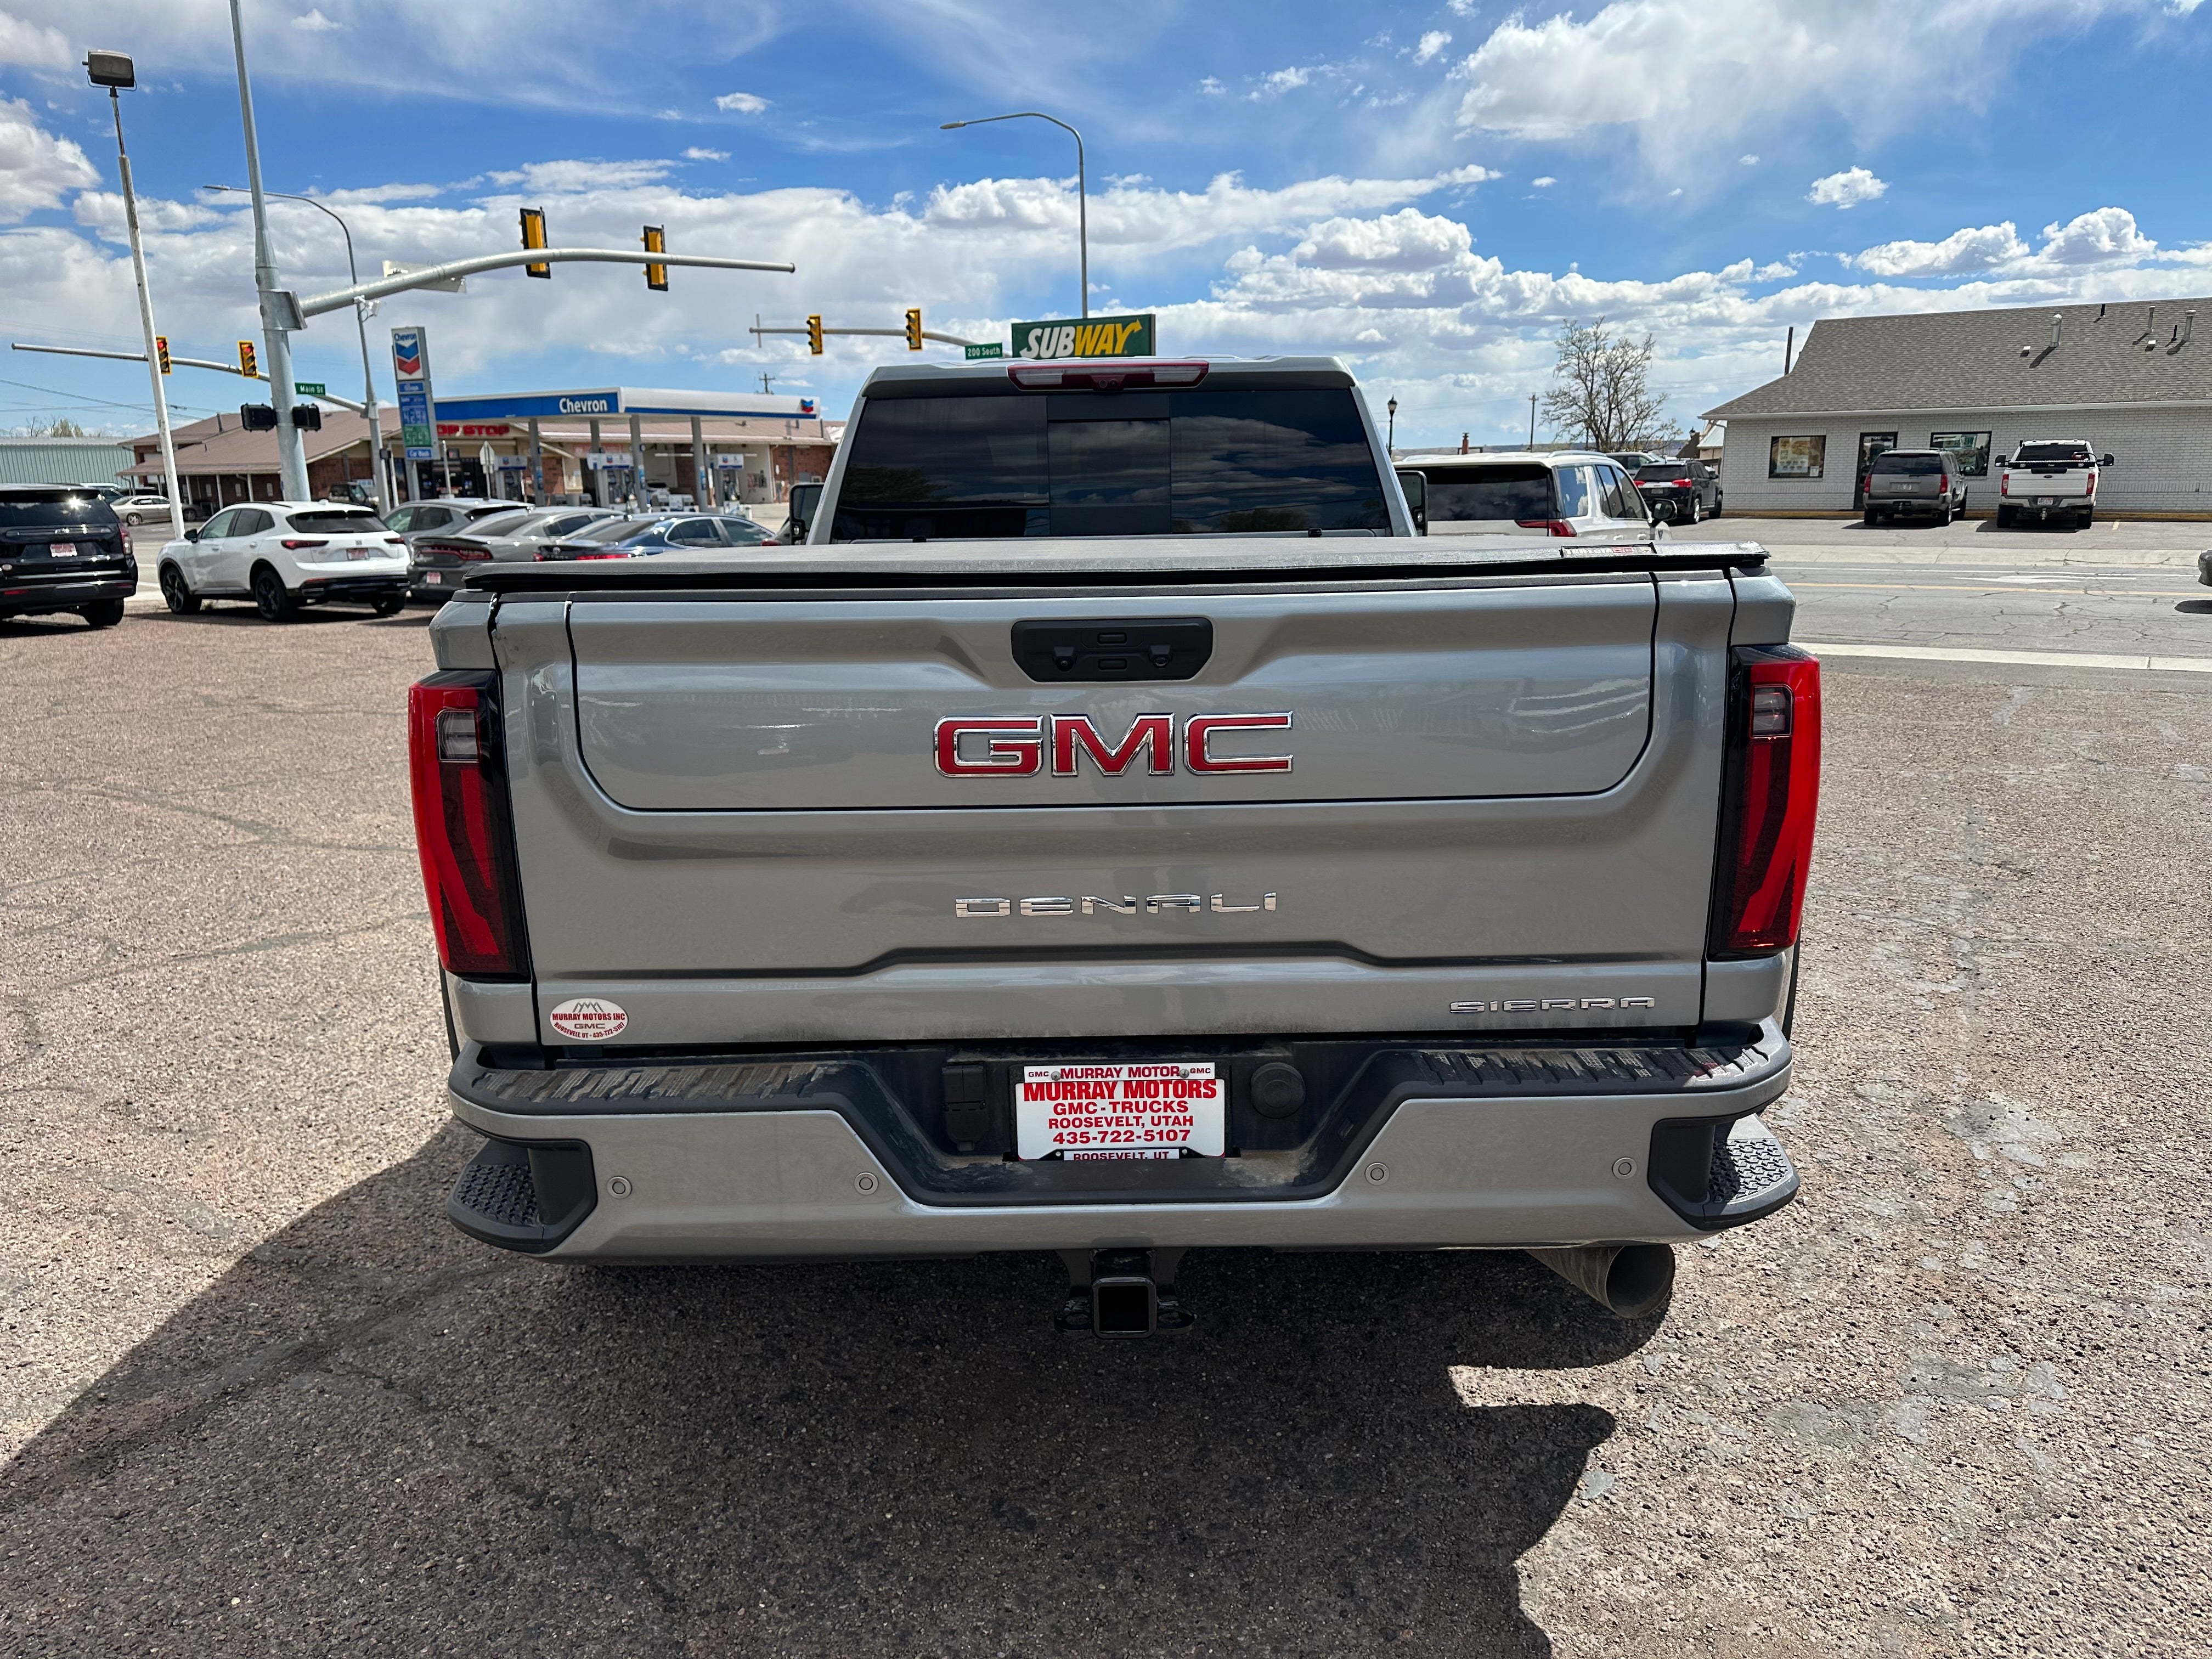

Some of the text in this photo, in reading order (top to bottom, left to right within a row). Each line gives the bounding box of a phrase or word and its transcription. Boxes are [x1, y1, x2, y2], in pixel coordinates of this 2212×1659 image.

[394, 332, 417, 341] Chevron
[1019, 319, 1142, 358] SUBWAY
[967, 346, 1001, 357] 200 South
[317, 385, 324, 393] St
[559, 398, 607, 413] Chevron
[437, 424, 510, 436] OP STOP
[934, 711, 1294, 776] GMC
[955, 891, 1277, 917] DENALI
[1449, 997, 1655, 1013] SIERRA
[593, 1022, 625, 1038] 435-722-5107
[1060, 1066, 1123, 1079] MURRAY
[1128, 1065, 1180, 1078] MOTOR
[1024, 1079, 1217, 1102] MURRAY MOTORS
[1048, 1115, 1193, 1129] ROOSEVELT, UTAH
[1053, 1130, 1190, 1144] 435-722-5107
[1154, 1151, 1169, 1160] UT
